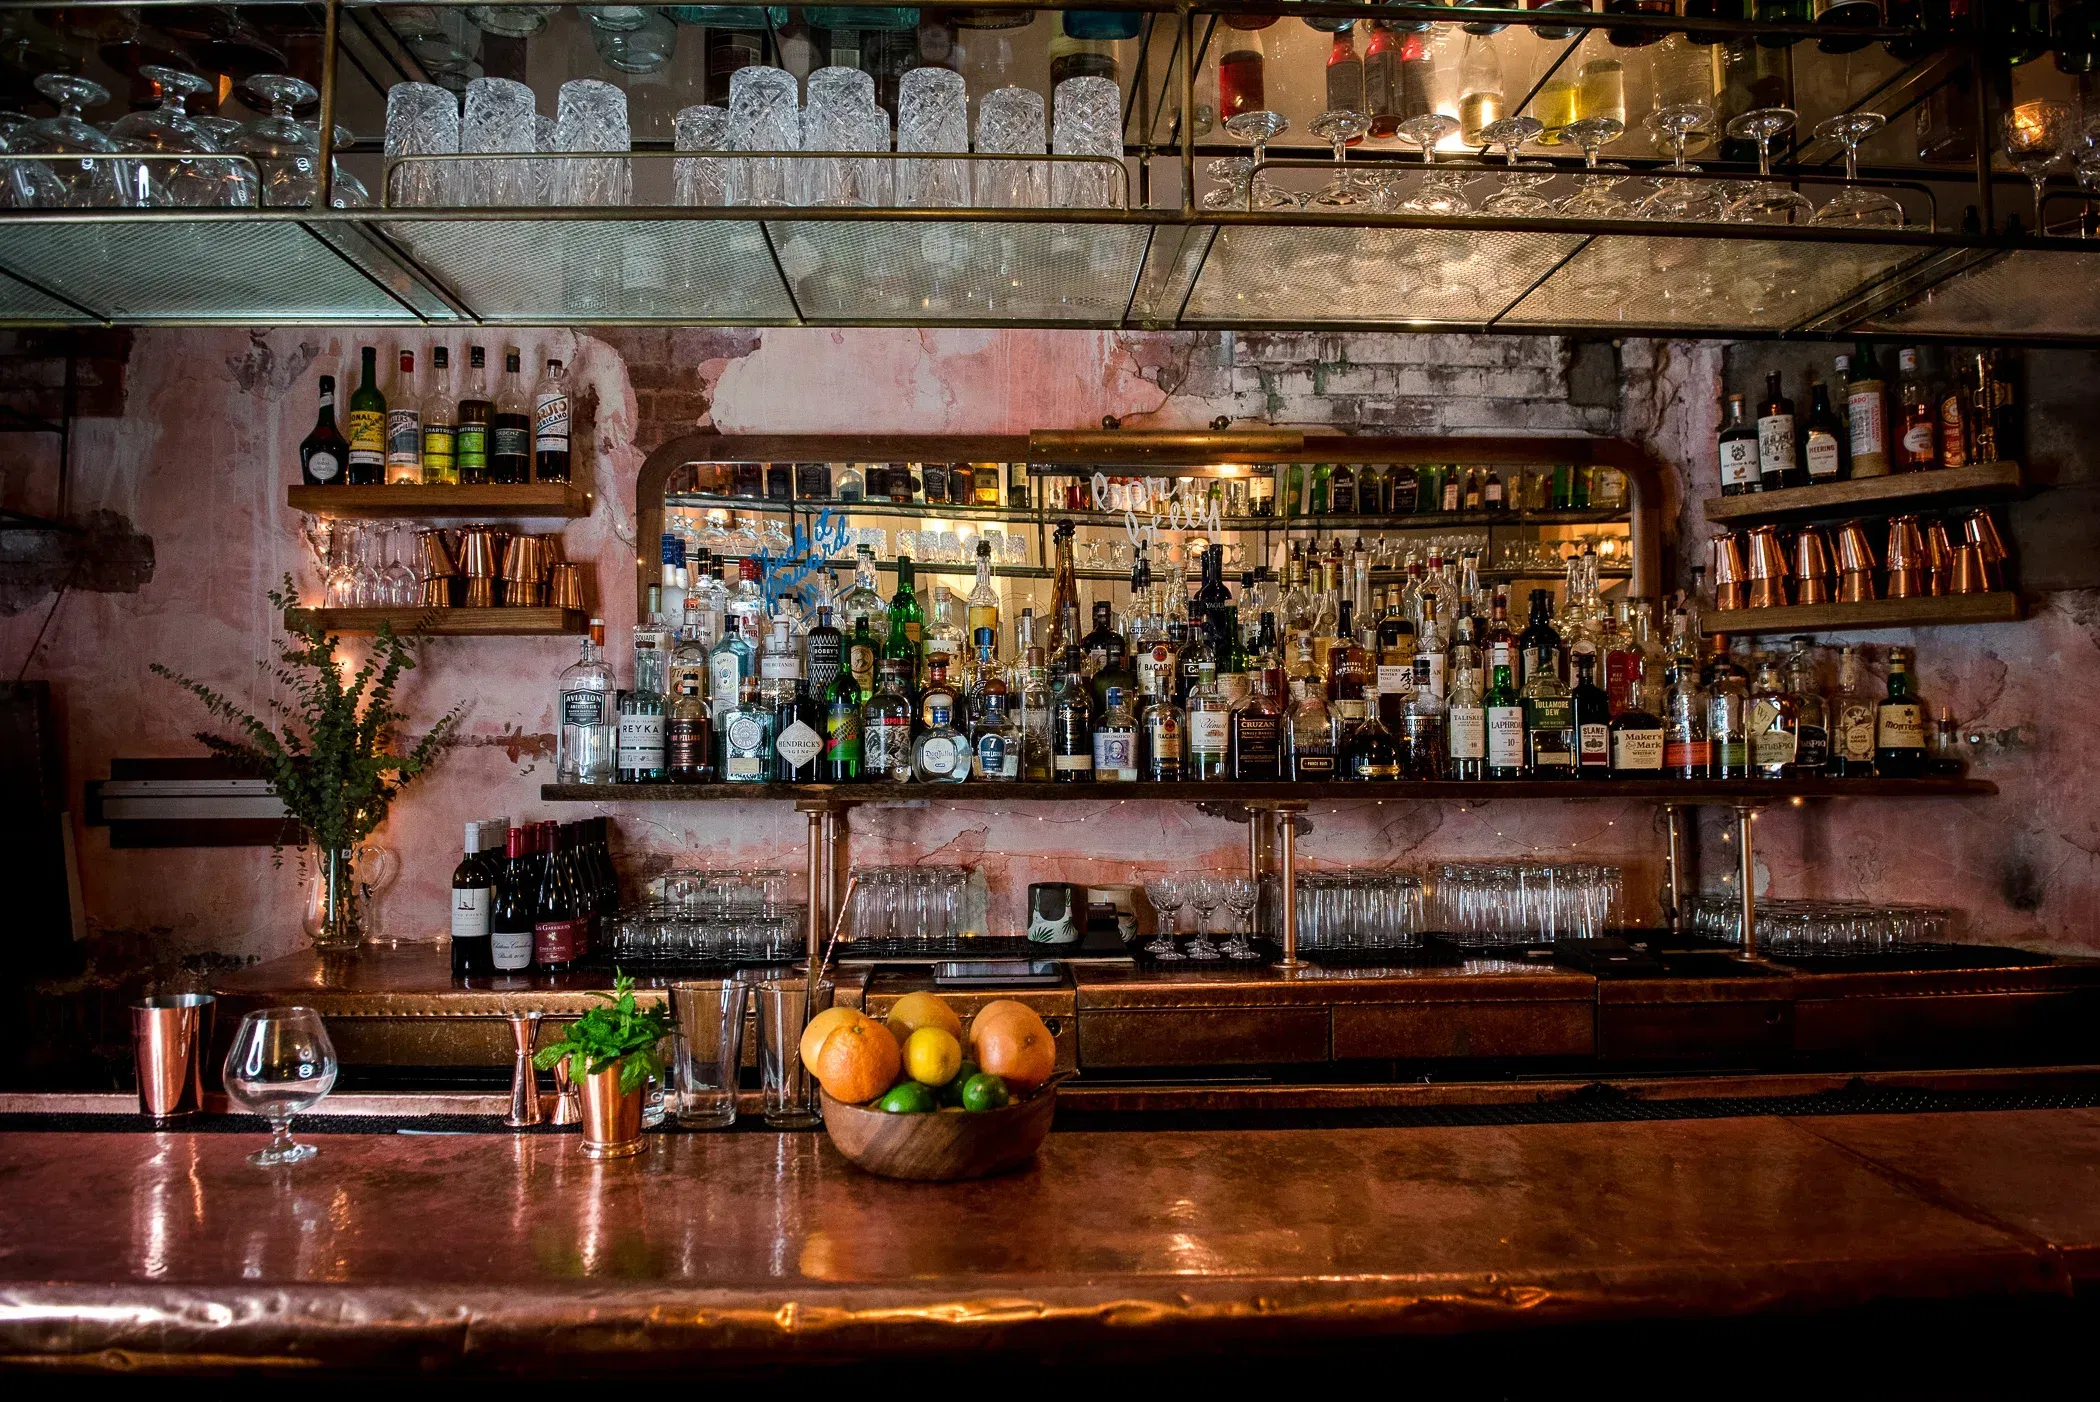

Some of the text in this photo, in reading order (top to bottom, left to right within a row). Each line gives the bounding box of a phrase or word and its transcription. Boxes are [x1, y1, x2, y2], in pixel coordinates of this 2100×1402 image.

[1808, 444, 1835, 453] HEERING
[1400, 668, 1412, 690] 季
[566, 694, 602, 703] AVIATION
[1534, 699, 1569, 709] TULLAMORE
[622, 725, 659, 733] REYKA
[989, 738, 997, 748] 7
[1508, 738, 1515, 746] 10
